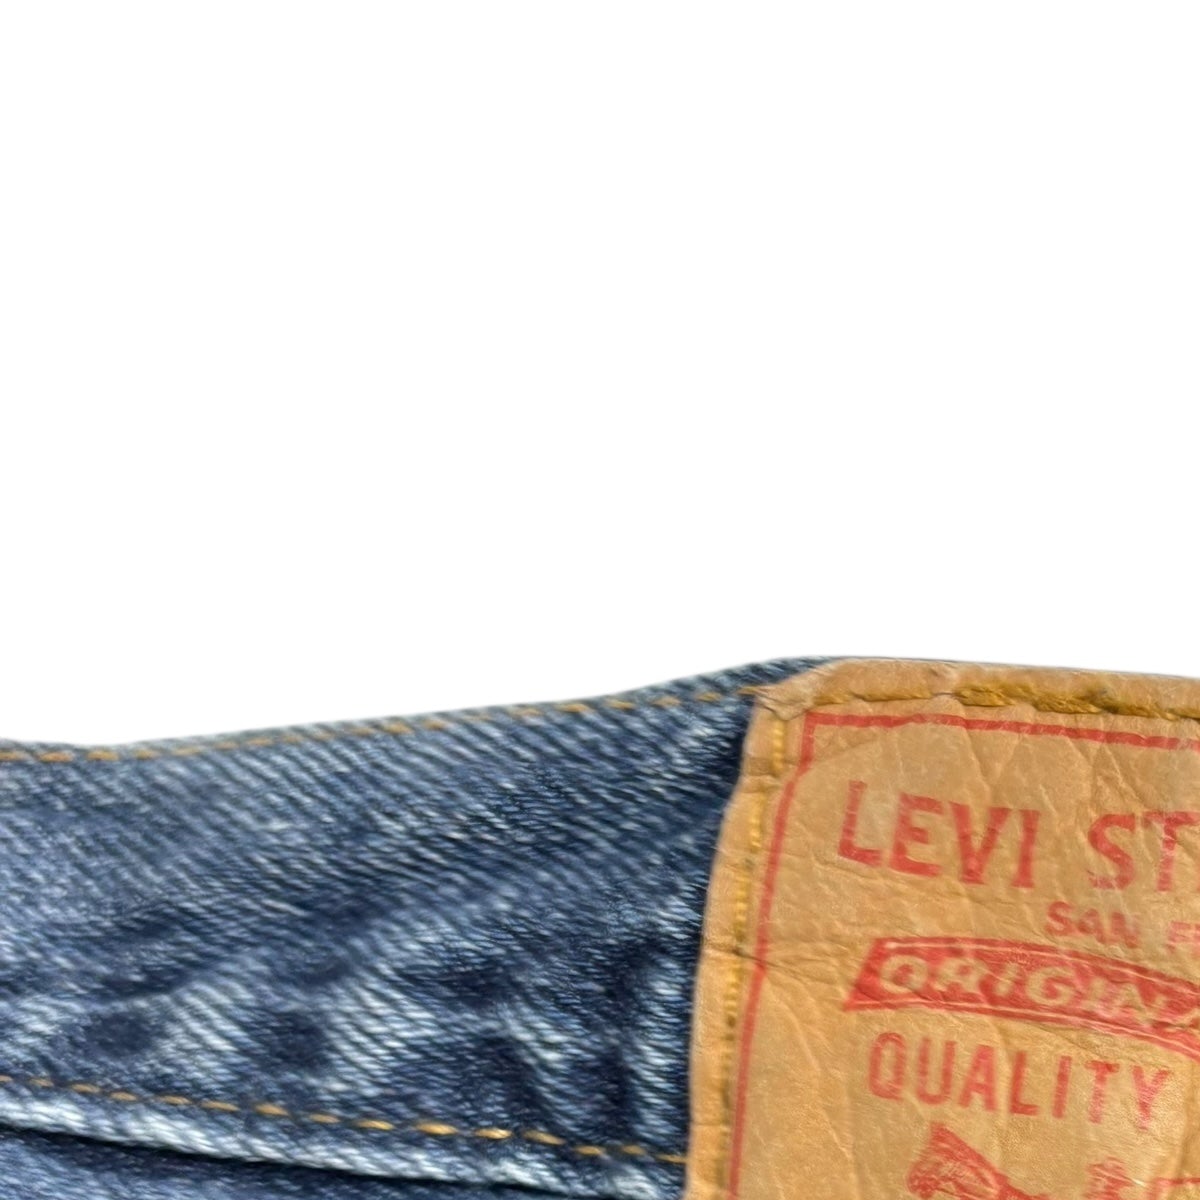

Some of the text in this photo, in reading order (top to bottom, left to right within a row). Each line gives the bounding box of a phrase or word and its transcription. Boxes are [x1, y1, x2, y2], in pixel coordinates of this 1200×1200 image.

[838, 779, 1040, 890] LEVI
[1045, 900, 1142, 949] SAN
[868, 1031, 1171, 1131] QUALITY
